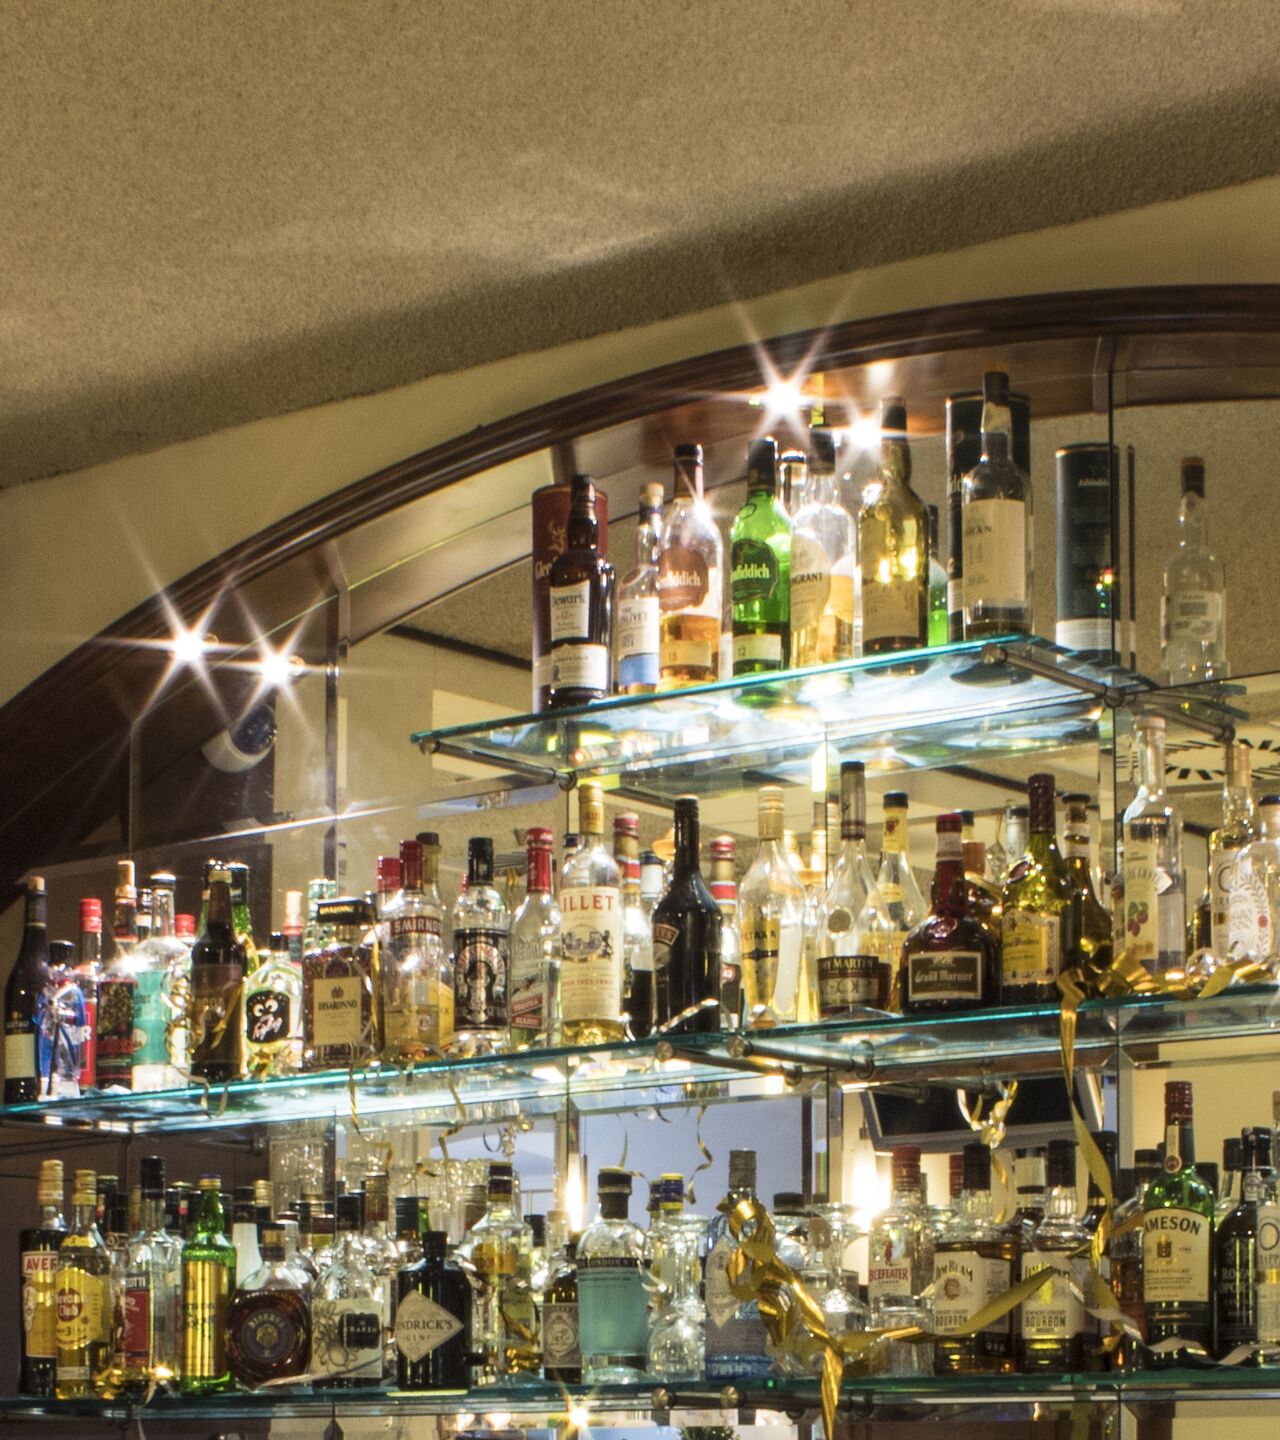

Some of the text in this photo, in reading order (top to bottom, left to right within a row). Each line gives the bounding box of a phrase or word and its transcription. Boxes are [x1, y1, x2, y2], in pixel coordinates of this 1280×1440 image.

[668, 651, 678, 662] 15
[737, 646, 746, 657] 12
[915, 970, 973, 983] Grand Marnier
[1025, 1315, 1066, 1327] BOURBON
